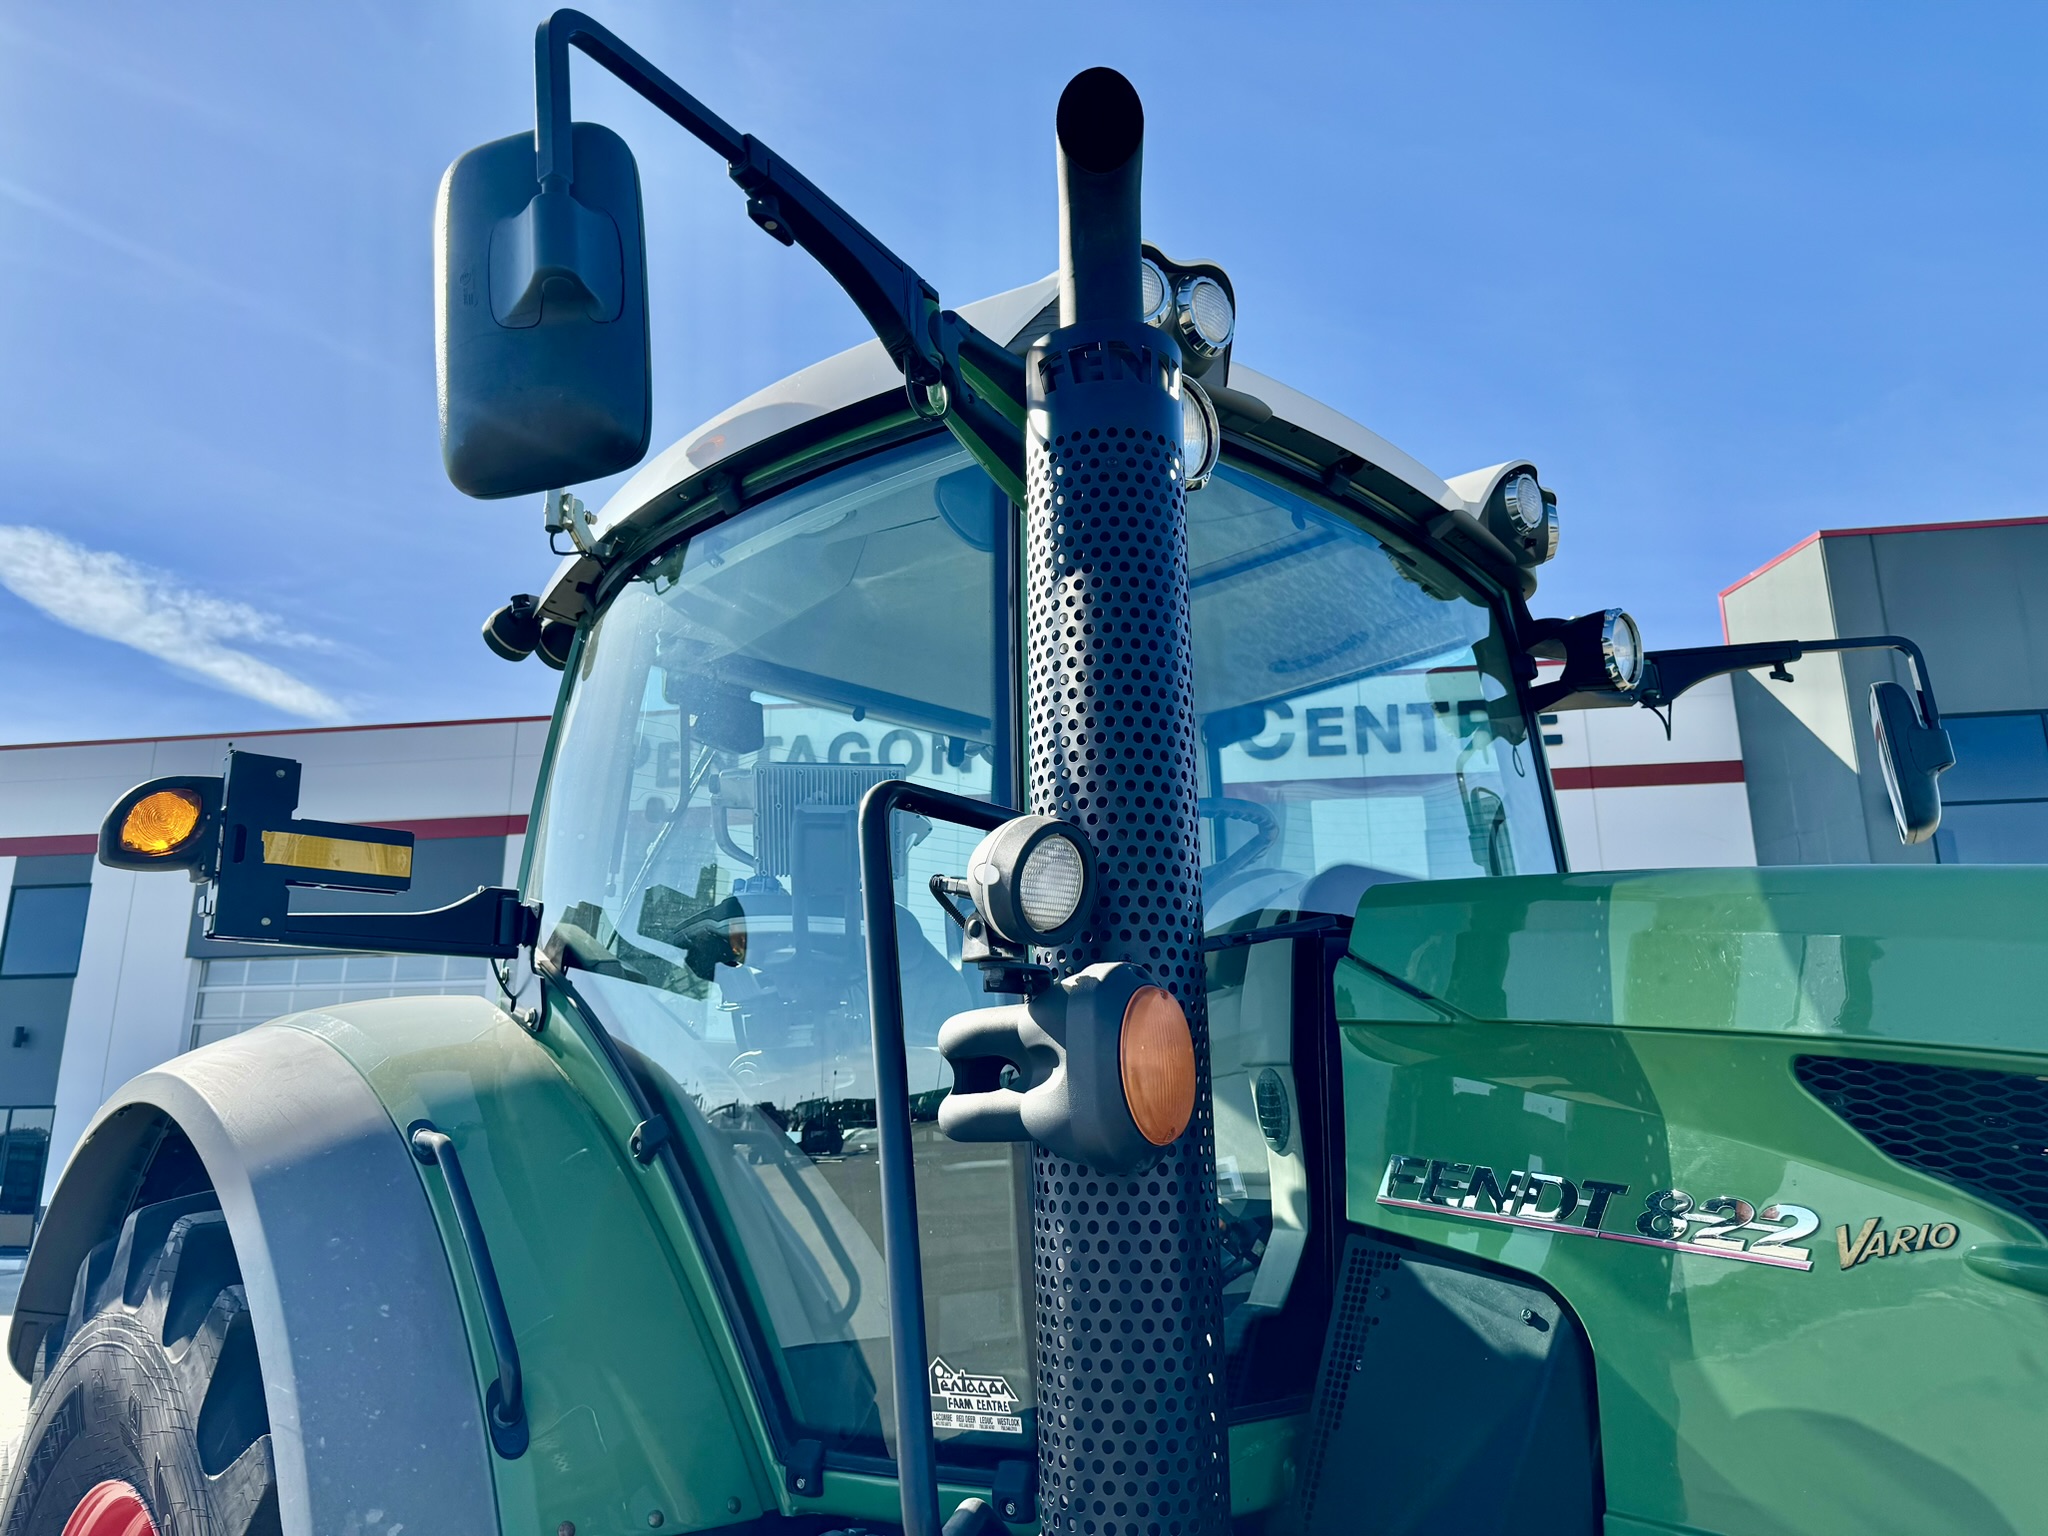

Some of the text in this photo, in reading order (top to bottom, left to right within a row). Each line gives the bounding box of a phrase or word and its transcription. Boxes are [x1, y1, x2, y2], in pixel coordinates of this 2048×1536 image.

[633, 729, 973, 788] ETAGON
[1377, 1154, 1631, 1233] FENDT
[1634, 1188, 1821, 1262] 822
[933, 1412, 953, 1422] LACOMBE
[955, 1414, 965, 1423] RED
[965, 1415, 976, 1424] DEER
[979, 1416, 994, 1425] LEDUC
[996, 1417, 1020, 1427] WESTLOCK
[947, 1397, 1010, 1412] FARM CENTRE
